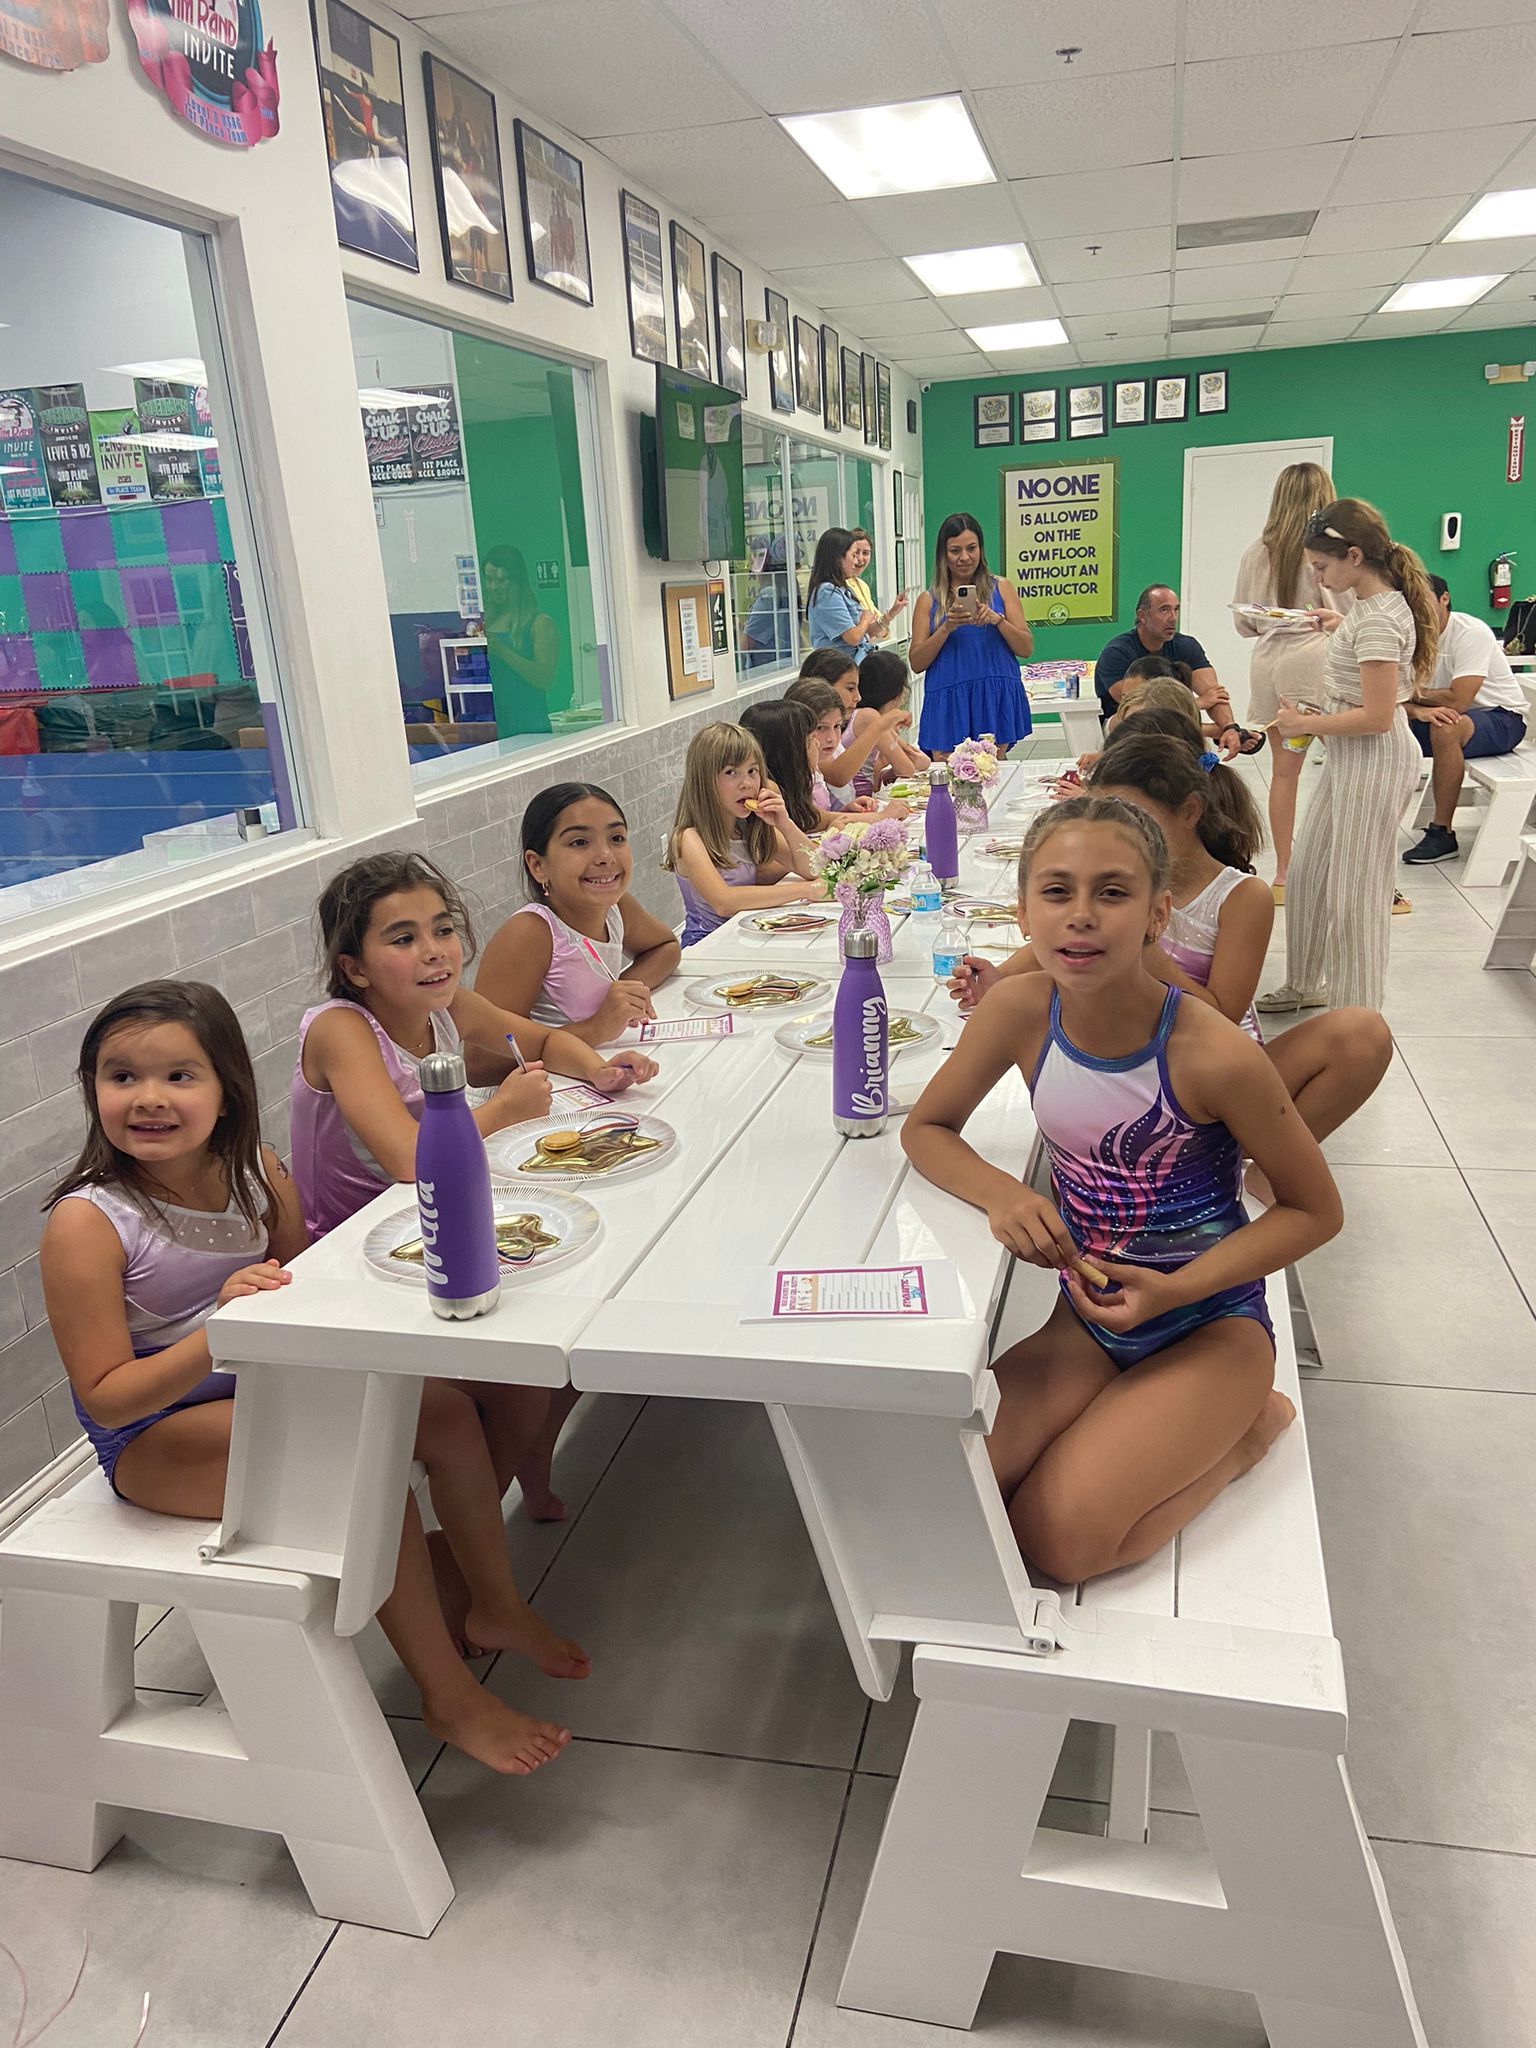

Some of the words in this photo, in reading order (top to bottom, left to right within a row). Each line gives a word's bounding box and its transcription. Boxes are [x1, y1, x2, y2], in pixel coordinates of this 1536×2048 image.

[169, 0, 194, 26] IM
[198, 0, 237, 49] RAND
[184, 30, 235, 79] INVITE
[152, 417, 181, 426] INVITE
[366, 413, 400, 428] CHALK
[416, 409, 450, 423] CHALK
[51, 424, 80, 434] INVITE
[380, 425, 399, 440] UP
[430, 421, 450, 437] UP
[4, 441, 34, 453] INVITE
[47, 445, 69, 461] LEVEL
[70, 444, 78, 460] 5
[100, 453, 143, 470] INVITE
[172, 463, 190, 474] PLACE
[372, 465, 384, 473] 1ST
[387, 464, 411, 472] PLACE
[436, 460, 458, 468] PLACE
[70, 469, 88, 481] PLACE
[168, 475, 184, 485] TEAM
[372, 472, 390, 481] XCEL
[391, 470, 412, 479] GOLD
[418, 469, 435, 478] XCEL
[17, 488, 31, 498] PLACE
[67, 481, 82, 492] TEAM
[1018, 478, 1051, 499] NO
[1053, 474, 1099, 496] ONE
[1021, 514, 1031, 526] IS
[1034, 509, 1098, 525] ALLOWED
[1034, 531, 1054, 543] ON
[1057, 529, 1081, 542] THE
[1019, 550, 1049, 562] GYM
[1052, 546, 1096, 561] FLOOR
[1017, 565, 1077, 580] WITHOUT
[1079, 564, 1098, 576] AN
[1018, 582, 1098, 598] INSTRUCTOR
[851, 996, 887, 1115] Brianny
